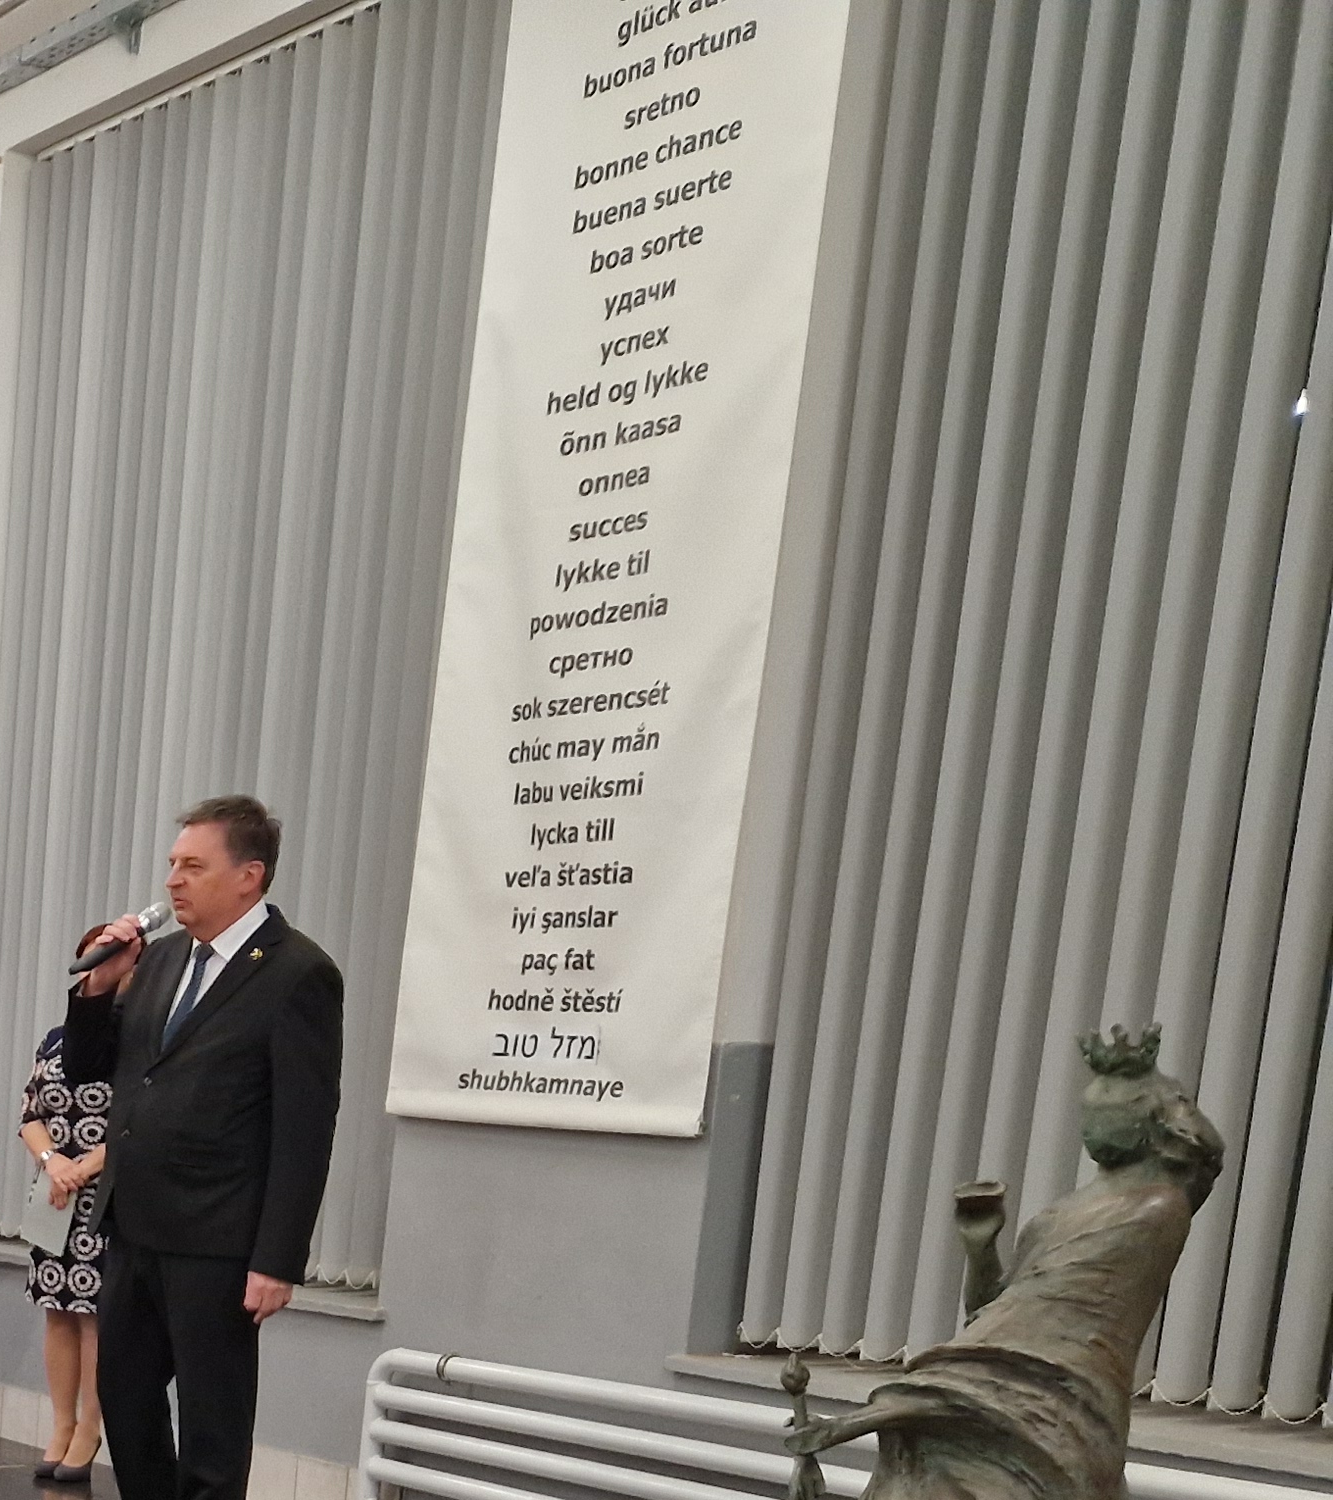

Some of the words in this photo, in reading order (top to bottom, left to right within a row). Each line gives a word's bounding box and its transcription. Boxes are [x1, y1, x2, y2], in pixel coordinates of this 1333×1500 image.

[617, 0, 682, 48] glück
[583, 56, 656, 99] buona
[663, 19, 758, 70] fortuna
[623, 86, 701, 131] sretno
[573, 150, 649, 191] bonne
[655, 119, 743, 164] chance
[572, 196, 647, 235] buena
[653, 169, 733, 211] suerte
[589, 245, 634, 275] boa
[640, 224, 704, 261] sorte
[604, 278, 677, 322] удачи
[600, 325, 670, 367] успех
[546, 381, 602, 416] held
[607, 379, 638, 406] og
[643, 360, 709, 399] lykke
[559, 430, 608, 457] õnn
[614, 414, 682, 447] kaasa
[578, 465, 651, 497] onnea
[568, 510, 649, 543] succes
[554, 557, 621, 593] lykke
[626, 548, 651, 577] til
[529, 593, 669, 641] powodzenia
[548, 647, 634, 679] сретно
[511, 696, 543, 723] sok
[546, 679, 671, 718] szerencsét
[508, 736, 552, 765] chúc
[556, 737, 606, 762] may
[513, 780, 554, 806] labu
[559, 771, 645, 802] veiksmi
[530, 821, 579, 852] lycka
[585, 817, 616, 843] till
[504, 864, 551, 889] veľa
[556, 860, 634, 887] šťastia
[511, 906, 537, 935] iyi
[540, 904, 619, 935] şanslar
[520, 953, 559, 977] paç
[564, 947, 596, 971] fat
[487, 987, 555, 1013] hodně
[559, 987, 624, 1014] štěstí
[491, 1033, 539, 1059] טוב
[550, 1026, 597, 1060] מזל
[457, 1067, 624, 1103] shubhkamnaye
